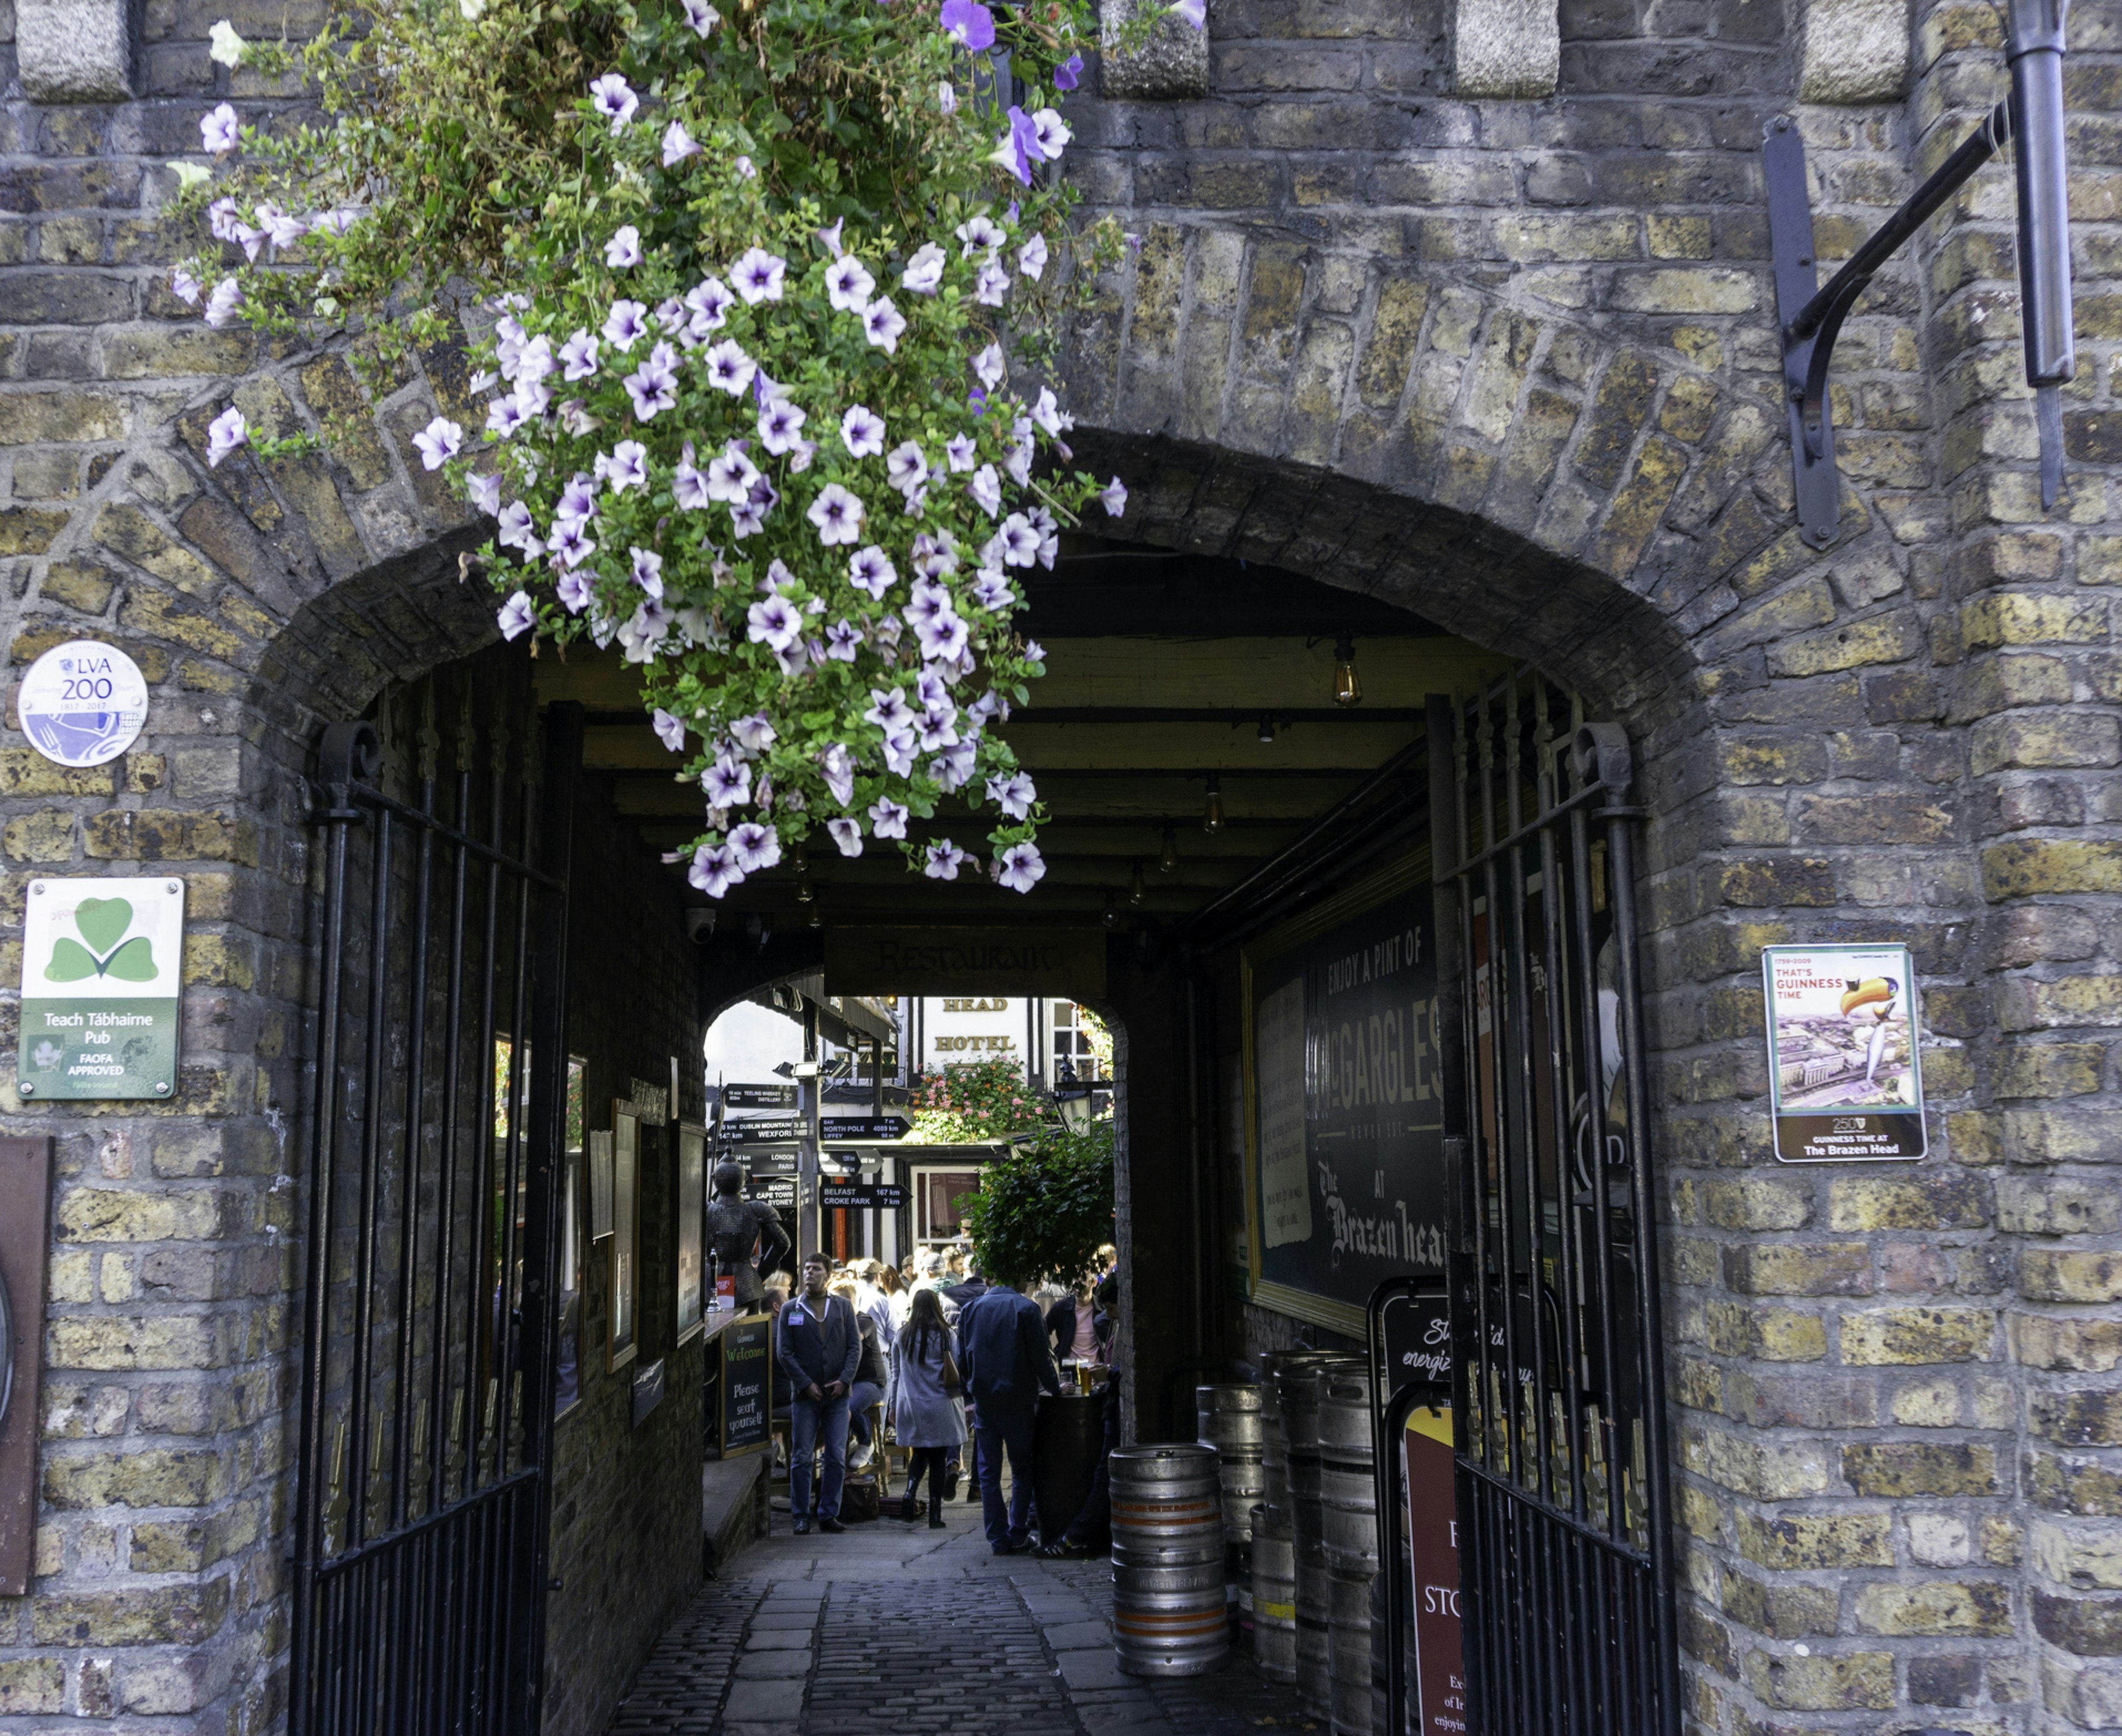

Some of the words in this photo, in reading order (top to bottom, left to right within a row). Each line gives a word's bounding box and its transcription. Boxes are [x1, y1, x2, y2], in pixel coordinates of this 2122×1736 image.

[78, 658, 112, 674] LVA
[61, 678, 112, 700] 200
[61, 702, 79, 711] 1817
[87, 702, 107, 710] 2017
[1328, 953, 1359, 996] ENJOY
[1363, 949, 1370, 983] A
[1374, 934, 1400, 979] PINT
[1405, 925, 1421, 966] OF
[1777, 979, 1842, 989] GUINNESS
[944, 998, 1007, 1012] HEAD
[44, 1013, 83, 1026] Teach
[87, 1012, 153, 1026] Tábhairne
[85, 1030, 110, 1044] Pub
[935, 1036, 1016, 1051] HOTEL
[79, 1054, 113, 1064] FAOFA
[68, 1066, 124, 1076] APPROVED
[1832, 1117, 1856, 1130] 250
[1813, 1135, 1855, 1144] GUINNESS
[1804, 1145, 1825, 1156] The
[1827, 1145, 1868, 1155] Brazen
[1869, 1144, 1899, 1154] Head
[1317, 1160, 1337, 1197] The
[1374, 1170, 1384, 1199] AT
[1325, 1195, 1398, 1267] Brazen
[1395, 1200, 1445, 1269] hea
[726, 1348, 766, 1362] Welcome
[734, 1383, 759, 1399] Please
[737, 1398, 756, 1416] seat
[729, 1412, 763, 1435] yourself
[1444, 1696, 1455, 1709] of
[1434, 1714, 1466, 1732] enjoyin
